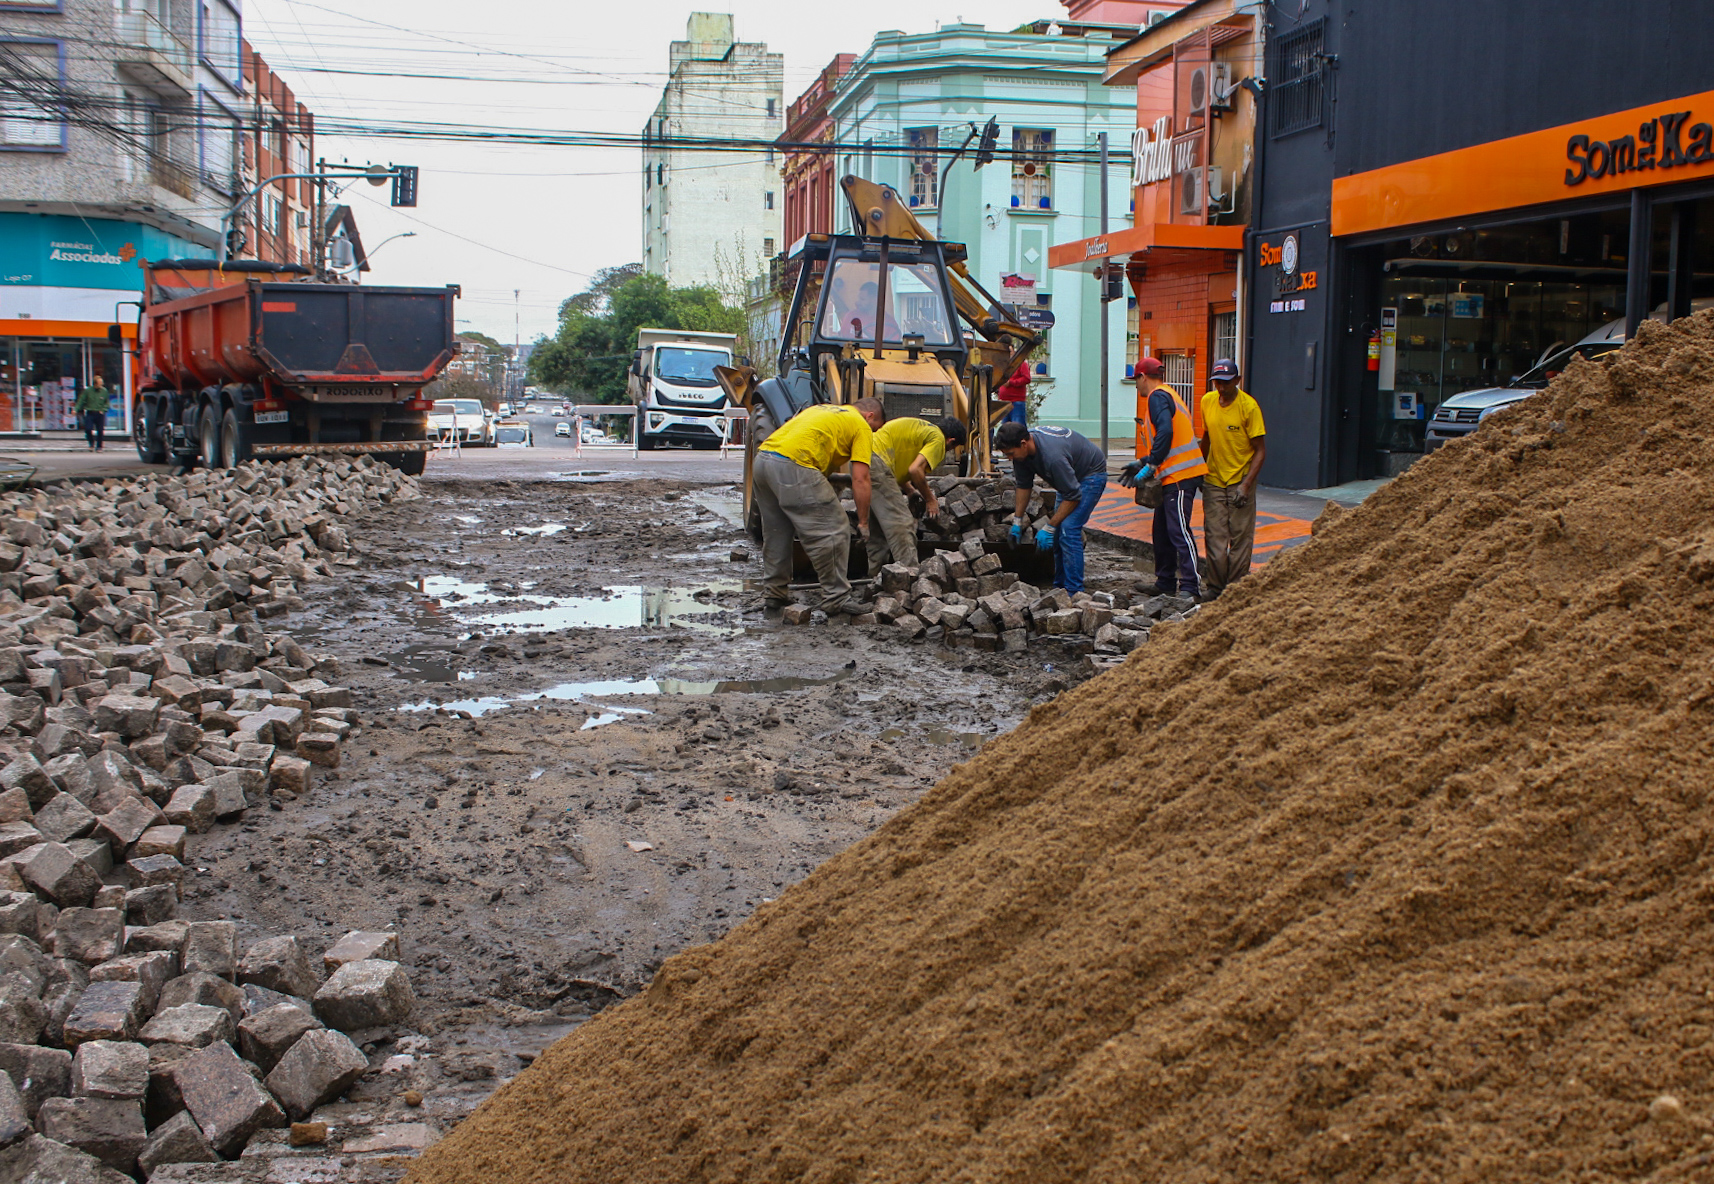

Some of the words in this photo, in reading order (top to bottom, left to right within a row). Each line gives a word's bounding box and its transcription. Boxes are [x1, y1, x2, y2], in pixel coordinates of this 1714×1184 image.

[1564, 134, 1636, 186] Som
[50, 248, 122, 265] Associadas
[1260, 242, 1283, 267] Som
